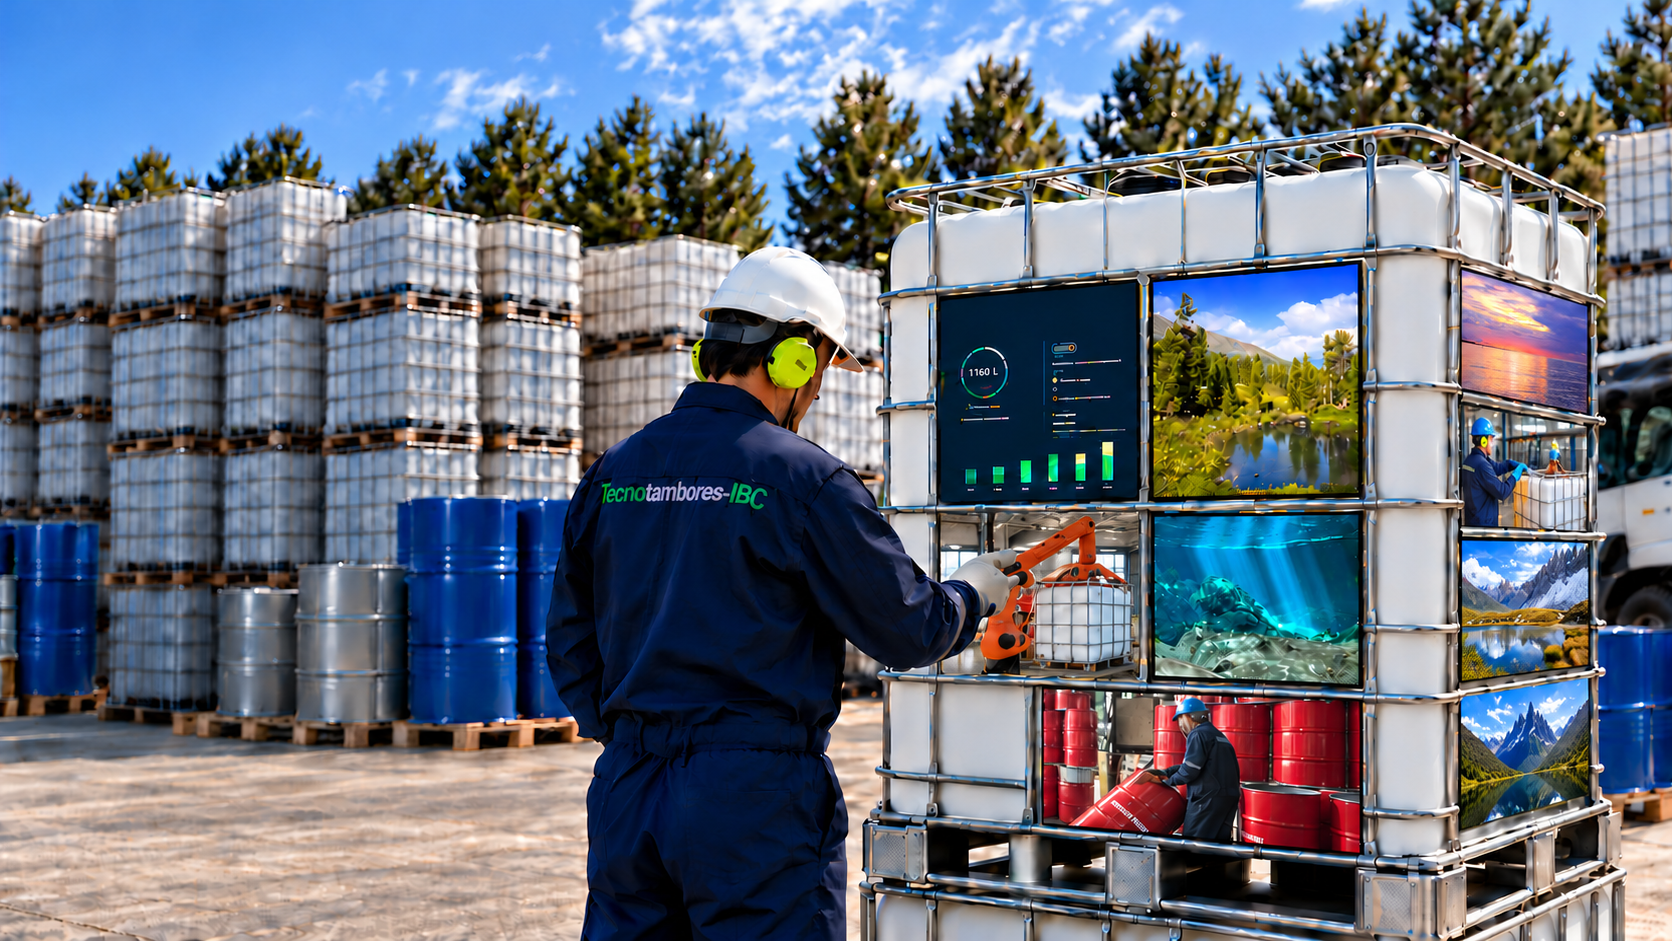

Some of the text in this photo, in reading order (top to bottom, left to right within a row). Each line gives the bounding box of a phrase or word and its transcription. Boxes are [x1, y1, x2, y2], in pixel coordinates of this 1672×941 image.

[968, 367, 998, 377] 1160 L
[601, 481, 768, 510] Tecnotambores-IBC
